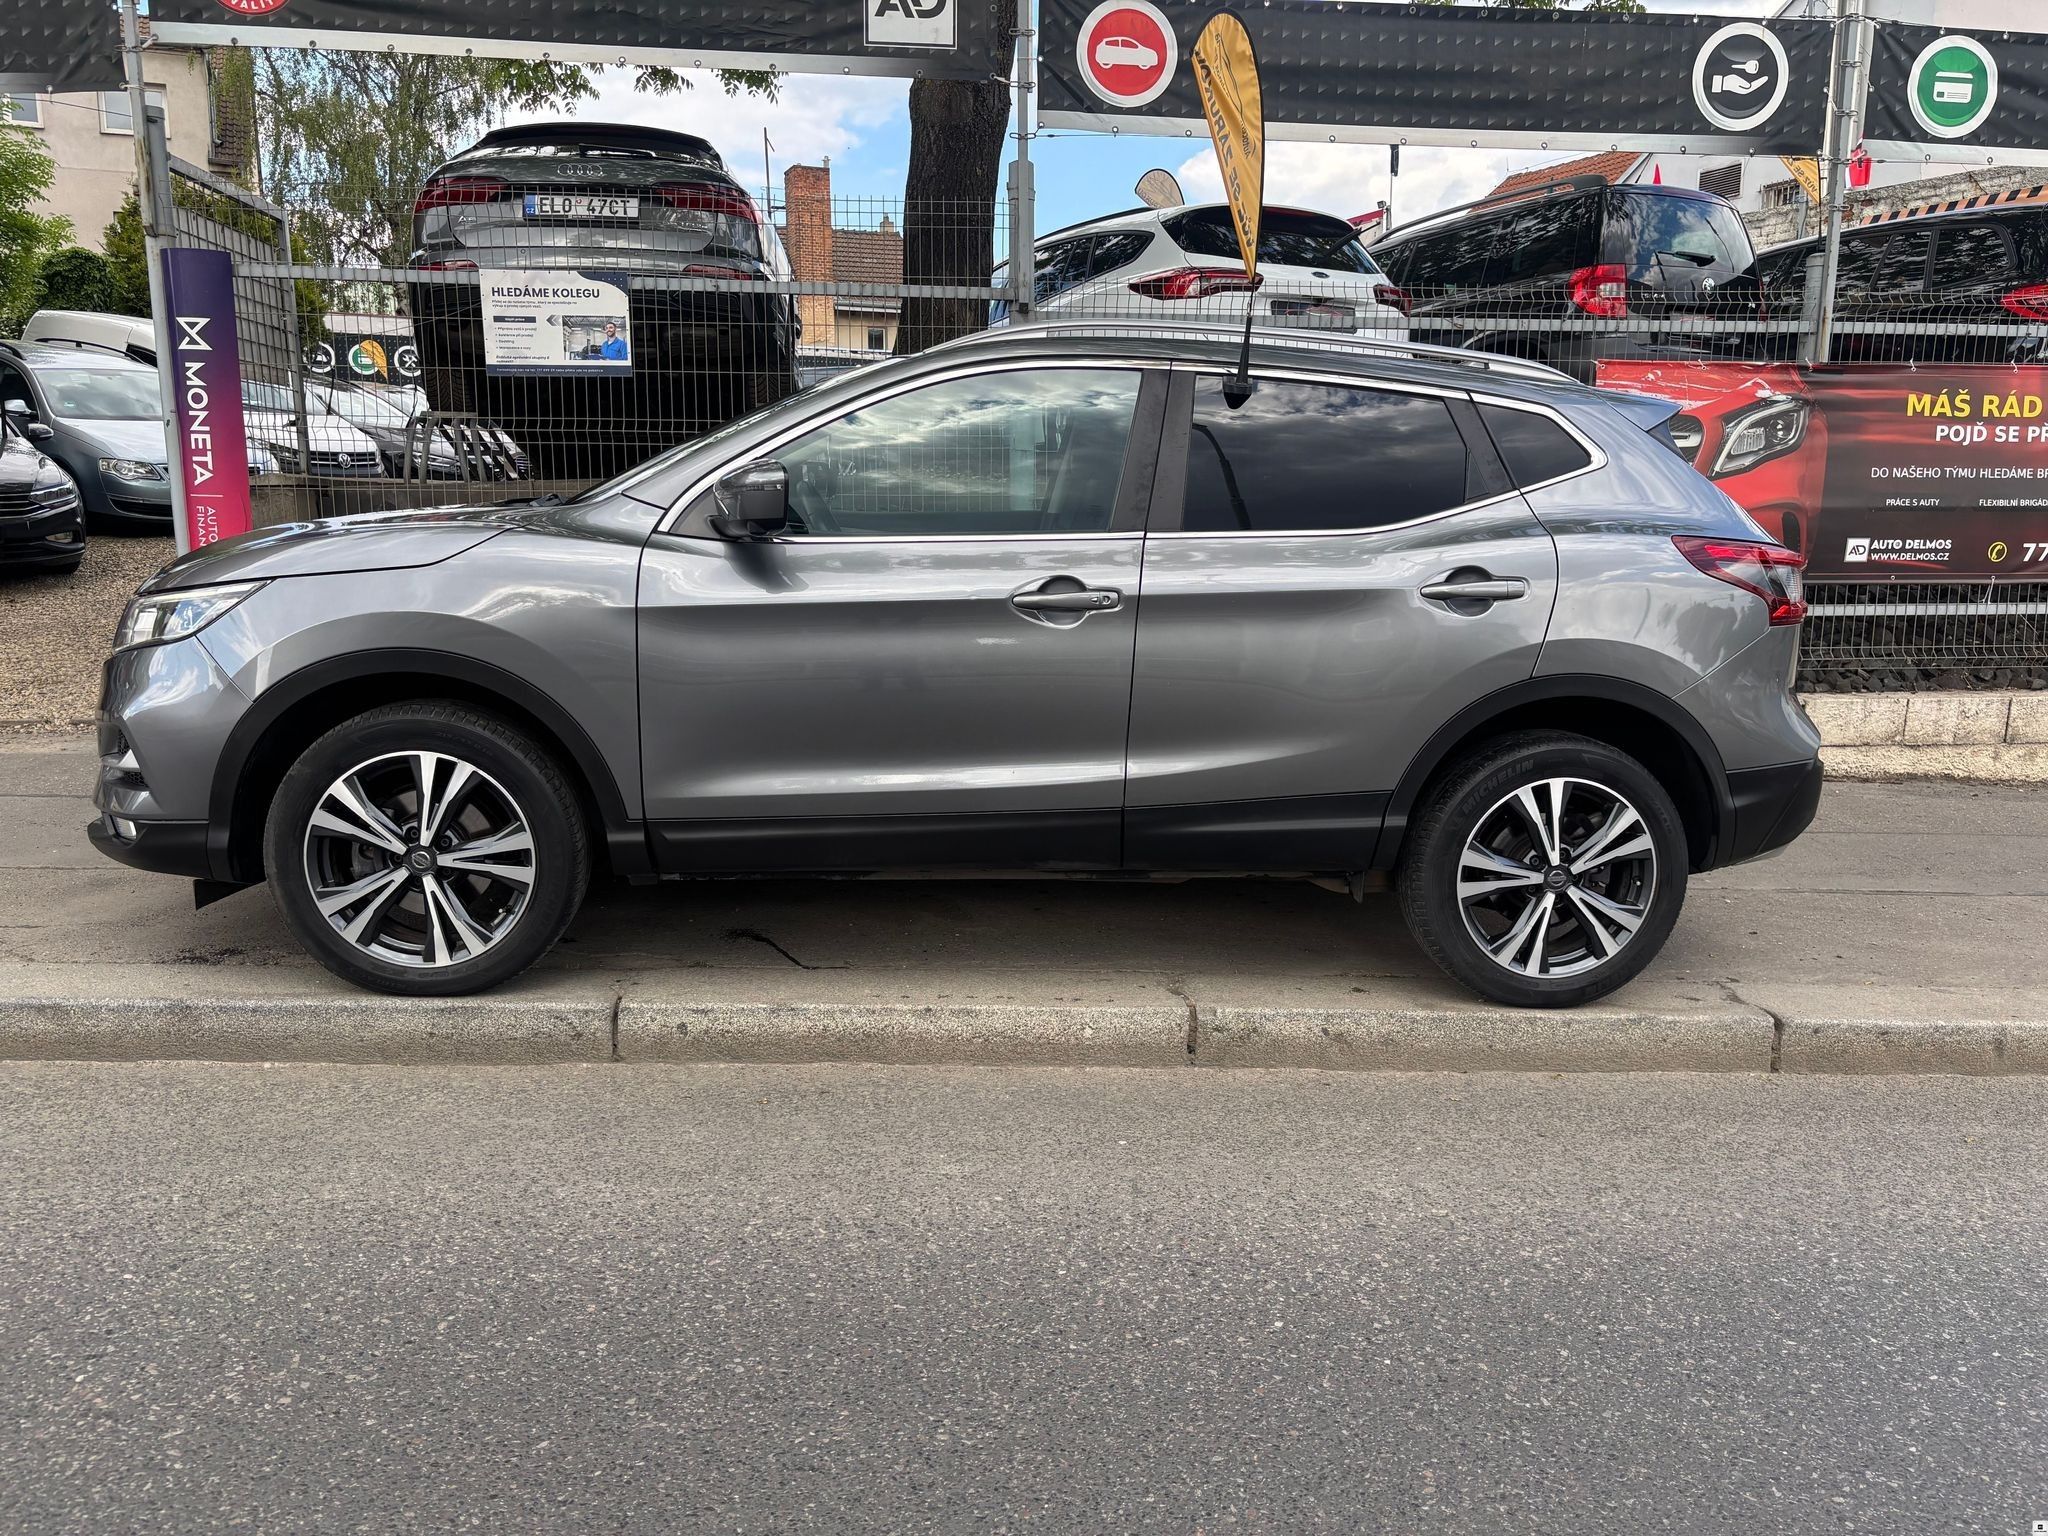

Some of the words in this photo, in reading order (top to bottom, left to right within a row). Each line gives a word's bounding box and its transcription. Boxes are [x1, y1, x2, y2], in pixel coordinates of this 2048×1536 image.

[586, 198, 630, 216] 47CT
[491, 284, 550, 298] HLEDÁME
[552, 287, 600, 298] KOLEGU
[1906, 388, 1971, 418] MÁŠ
[1982, 390, 2043, 418] RÁD
[184, 362, 214, 486] MONETA
[1935, 421, 1988, 446] POJĎ
[1994, 425, 2020, 443] SE
[1871, 467, 1889, 478] DO
[1892, 465, 1941, 478] NAŠEHO
[1944, 465, 1976, 479] TÝMU
[1979, 466, 2034, 479] HLEDÁME
[1886, 497, 1911, 506] PRÁCE
[1919, 498, 1940, 506] AUTY
[1979, 498, 2019, 507] FLEXIBILNÍ
[206, 506, 218, 542] AUTO
[1848, 544, 1866, 556] AD
[1871, 539, 1903, 549] AUTO
[1905, 539, 1952, 550] DELMOS
[1871, 552, 1950, 561] WWW.DELMOS.CZ
